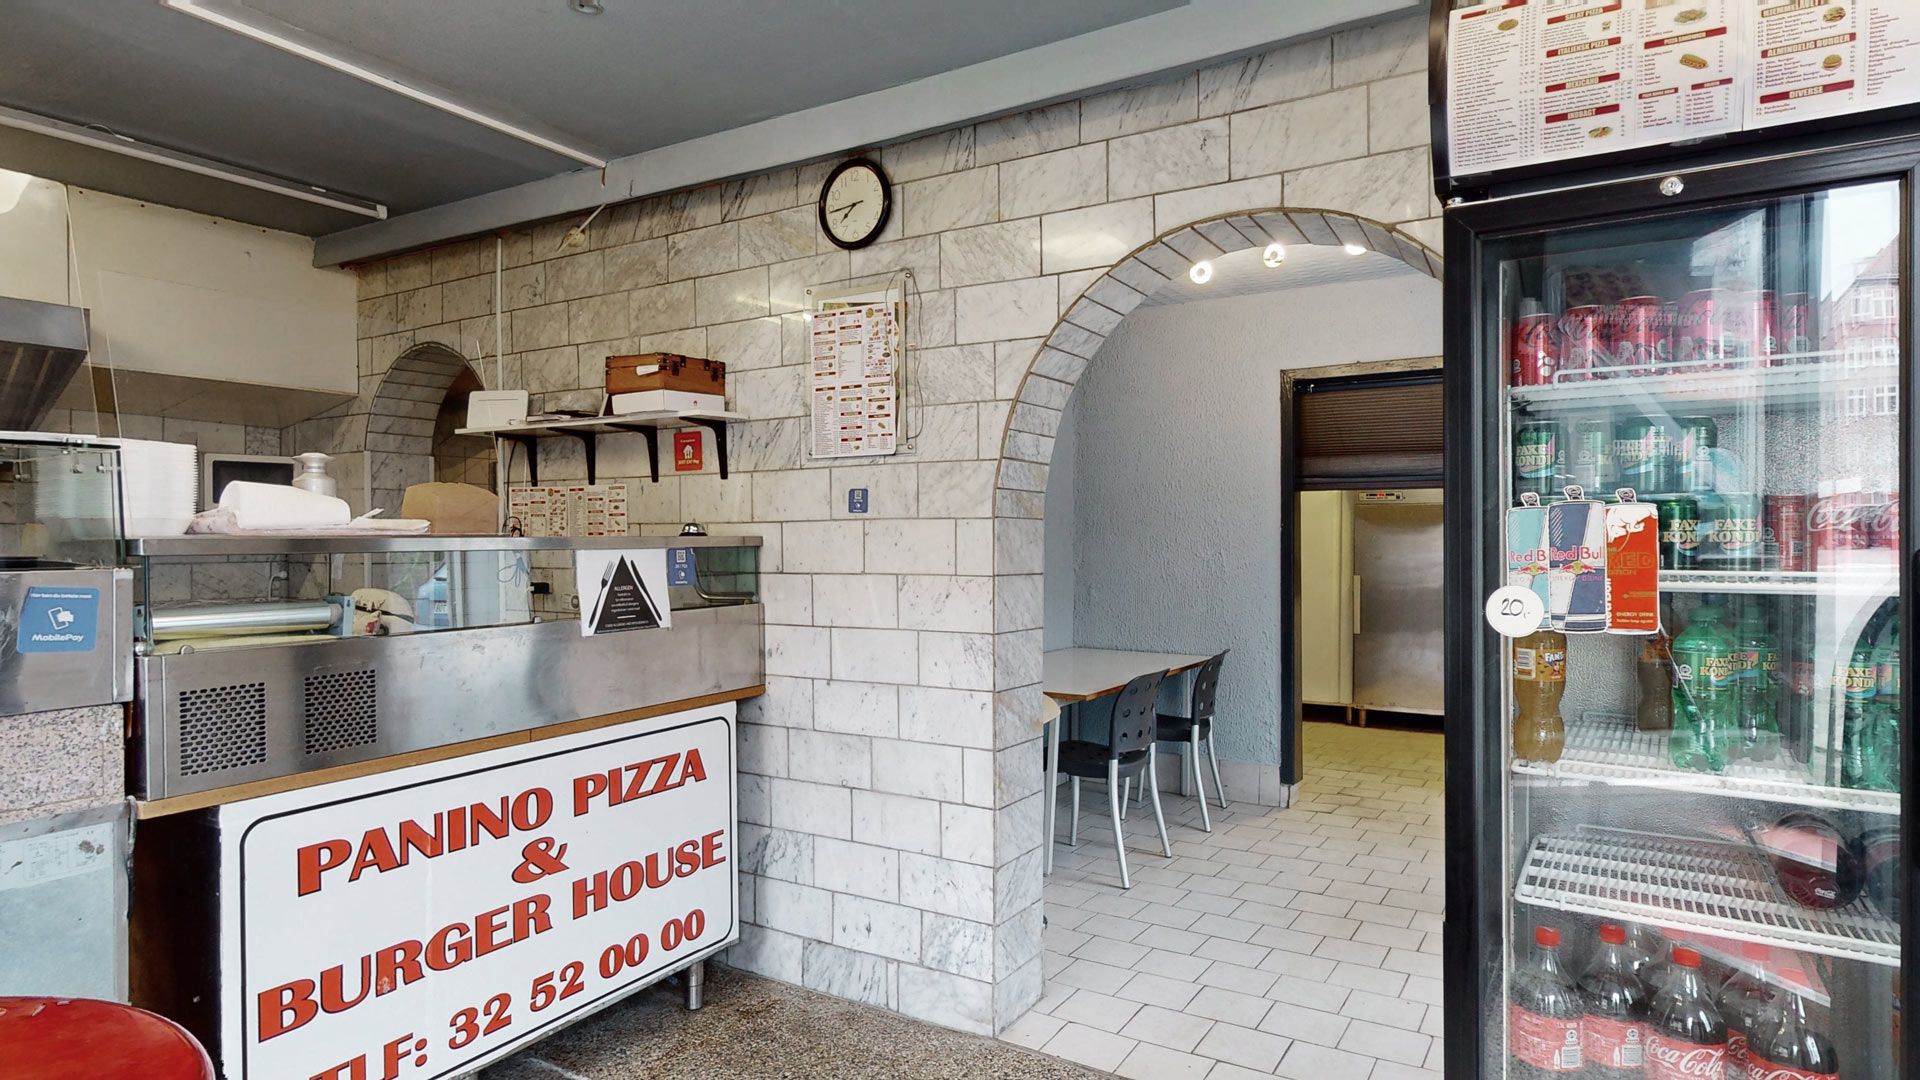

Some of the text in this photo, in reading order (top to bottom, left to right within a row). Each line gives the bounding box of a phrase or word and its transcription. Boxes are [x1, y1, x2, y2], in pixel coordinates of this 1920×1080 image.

[1586, 8, 1603, 17] PIZZA
[1591, 39, 1608, 49] PIZZA
[1816, 34, 1850, 49] BURGER
[1789, 85, 1824, 99] DIVERSE
[1671, 519, 1701, 530] FAX
[1662, 531, 1699, 543] KON
[32, 633, 84, 642] MobilePay
[297, 748, 707, 897] PANINO PIZZA
[511, 836, 570, 884] &
[257, 829, 726, 1043] BURGER HOUSE
[449, 993, 512, 1050] 32
[530, 961, 585, 1013] 52
[599, 932, 650, 979] 00
[661, 908, 706, 952] 00
